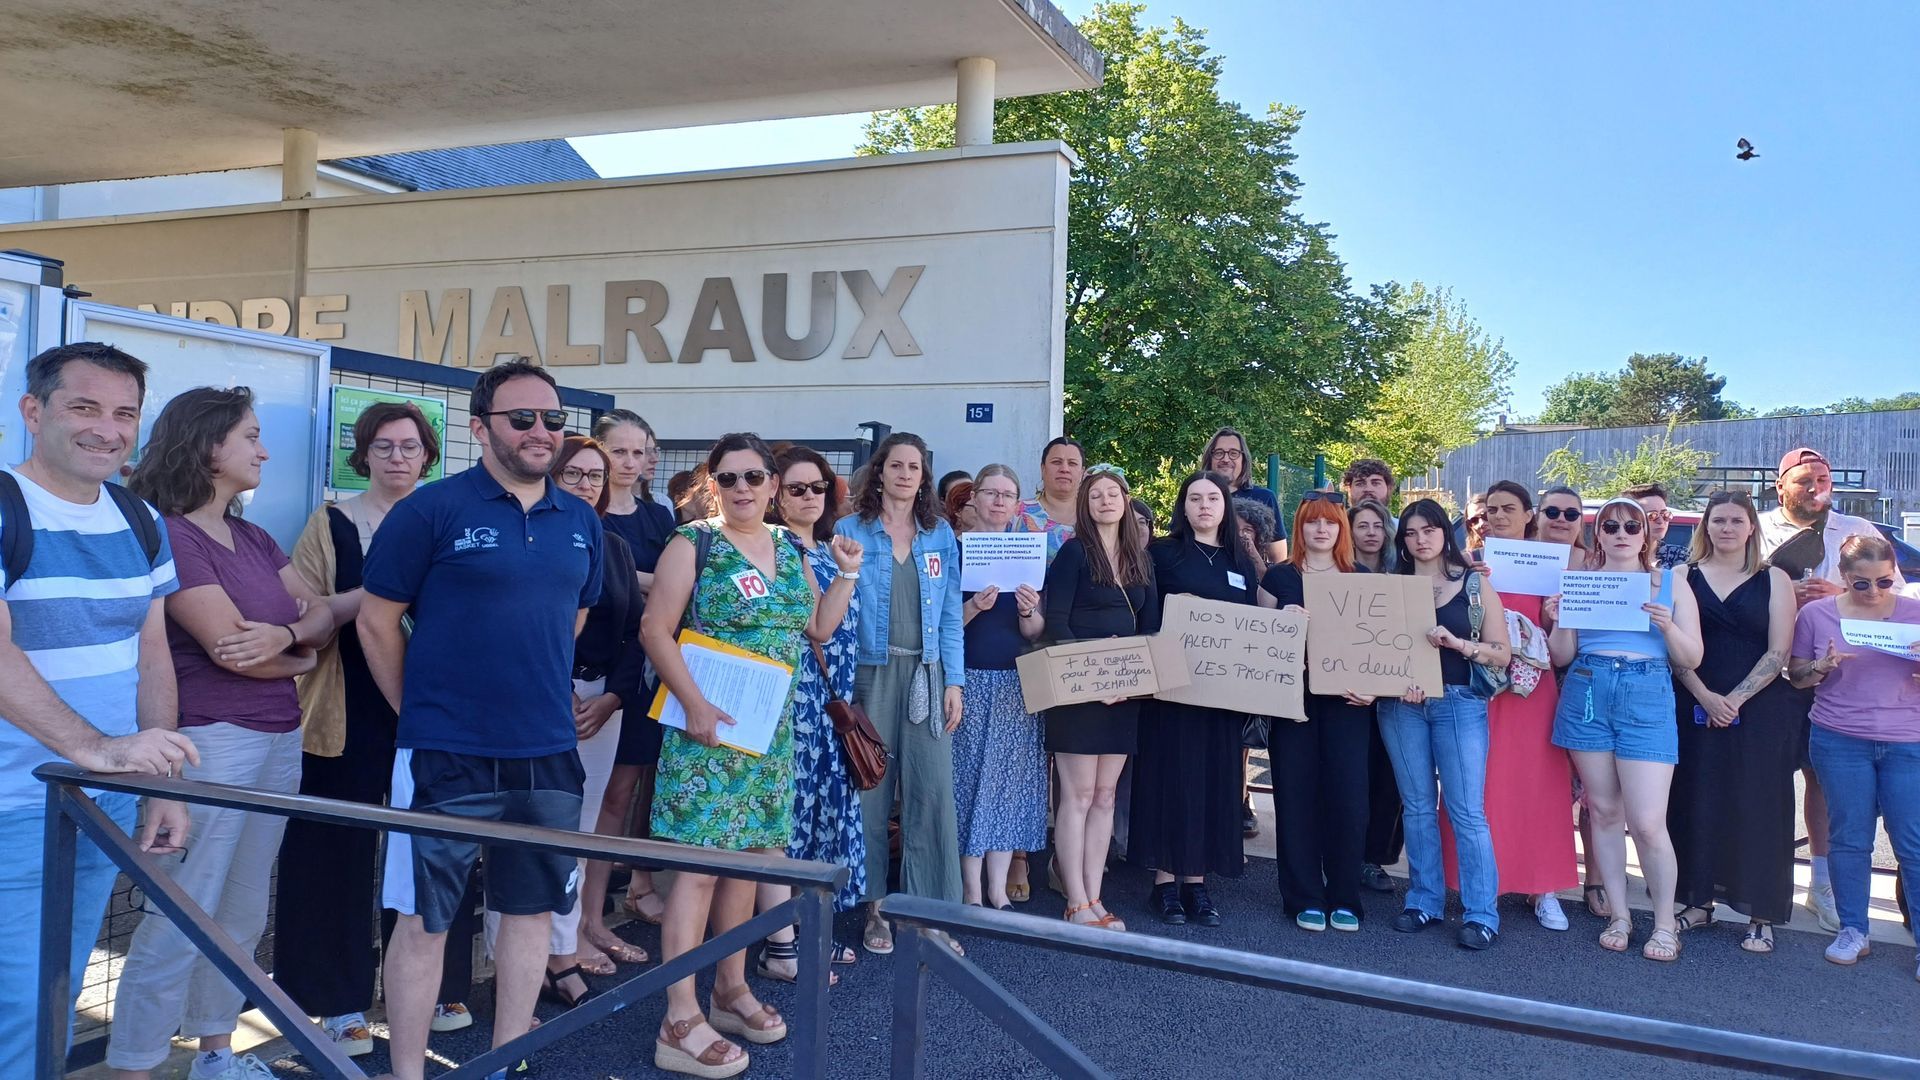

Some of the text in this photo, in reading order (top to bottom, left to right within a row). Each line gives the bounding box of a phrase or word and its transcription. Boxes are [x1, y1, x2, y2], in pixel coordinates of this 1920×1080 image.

[138, 264, 926, 367] DRE MALRAUX
[929, 558, 940, 577] FO
[739, 575, 765, 598] FO
[1328, 590, 1387, 618] VIE
[1189, 610, 1225, 624] NOS
[1234, 617, 1268, 634] VIES
[1352, 622, 1413, 651] SCO
[1845, 631, 1872, 639] SOUTIEN
[1084, 656, 1100, 667] de
[1104, 652, 1143, 670] moyens
[1266, 646, 1296, 663] QUE
[1322, 653, 1415, 679] en deuil
[1060, 670, 1089, 684] pour
[1194, 660, 1295, 686] LES PROFITS
[1071, 679, 1139, 693] de DEMAIN
